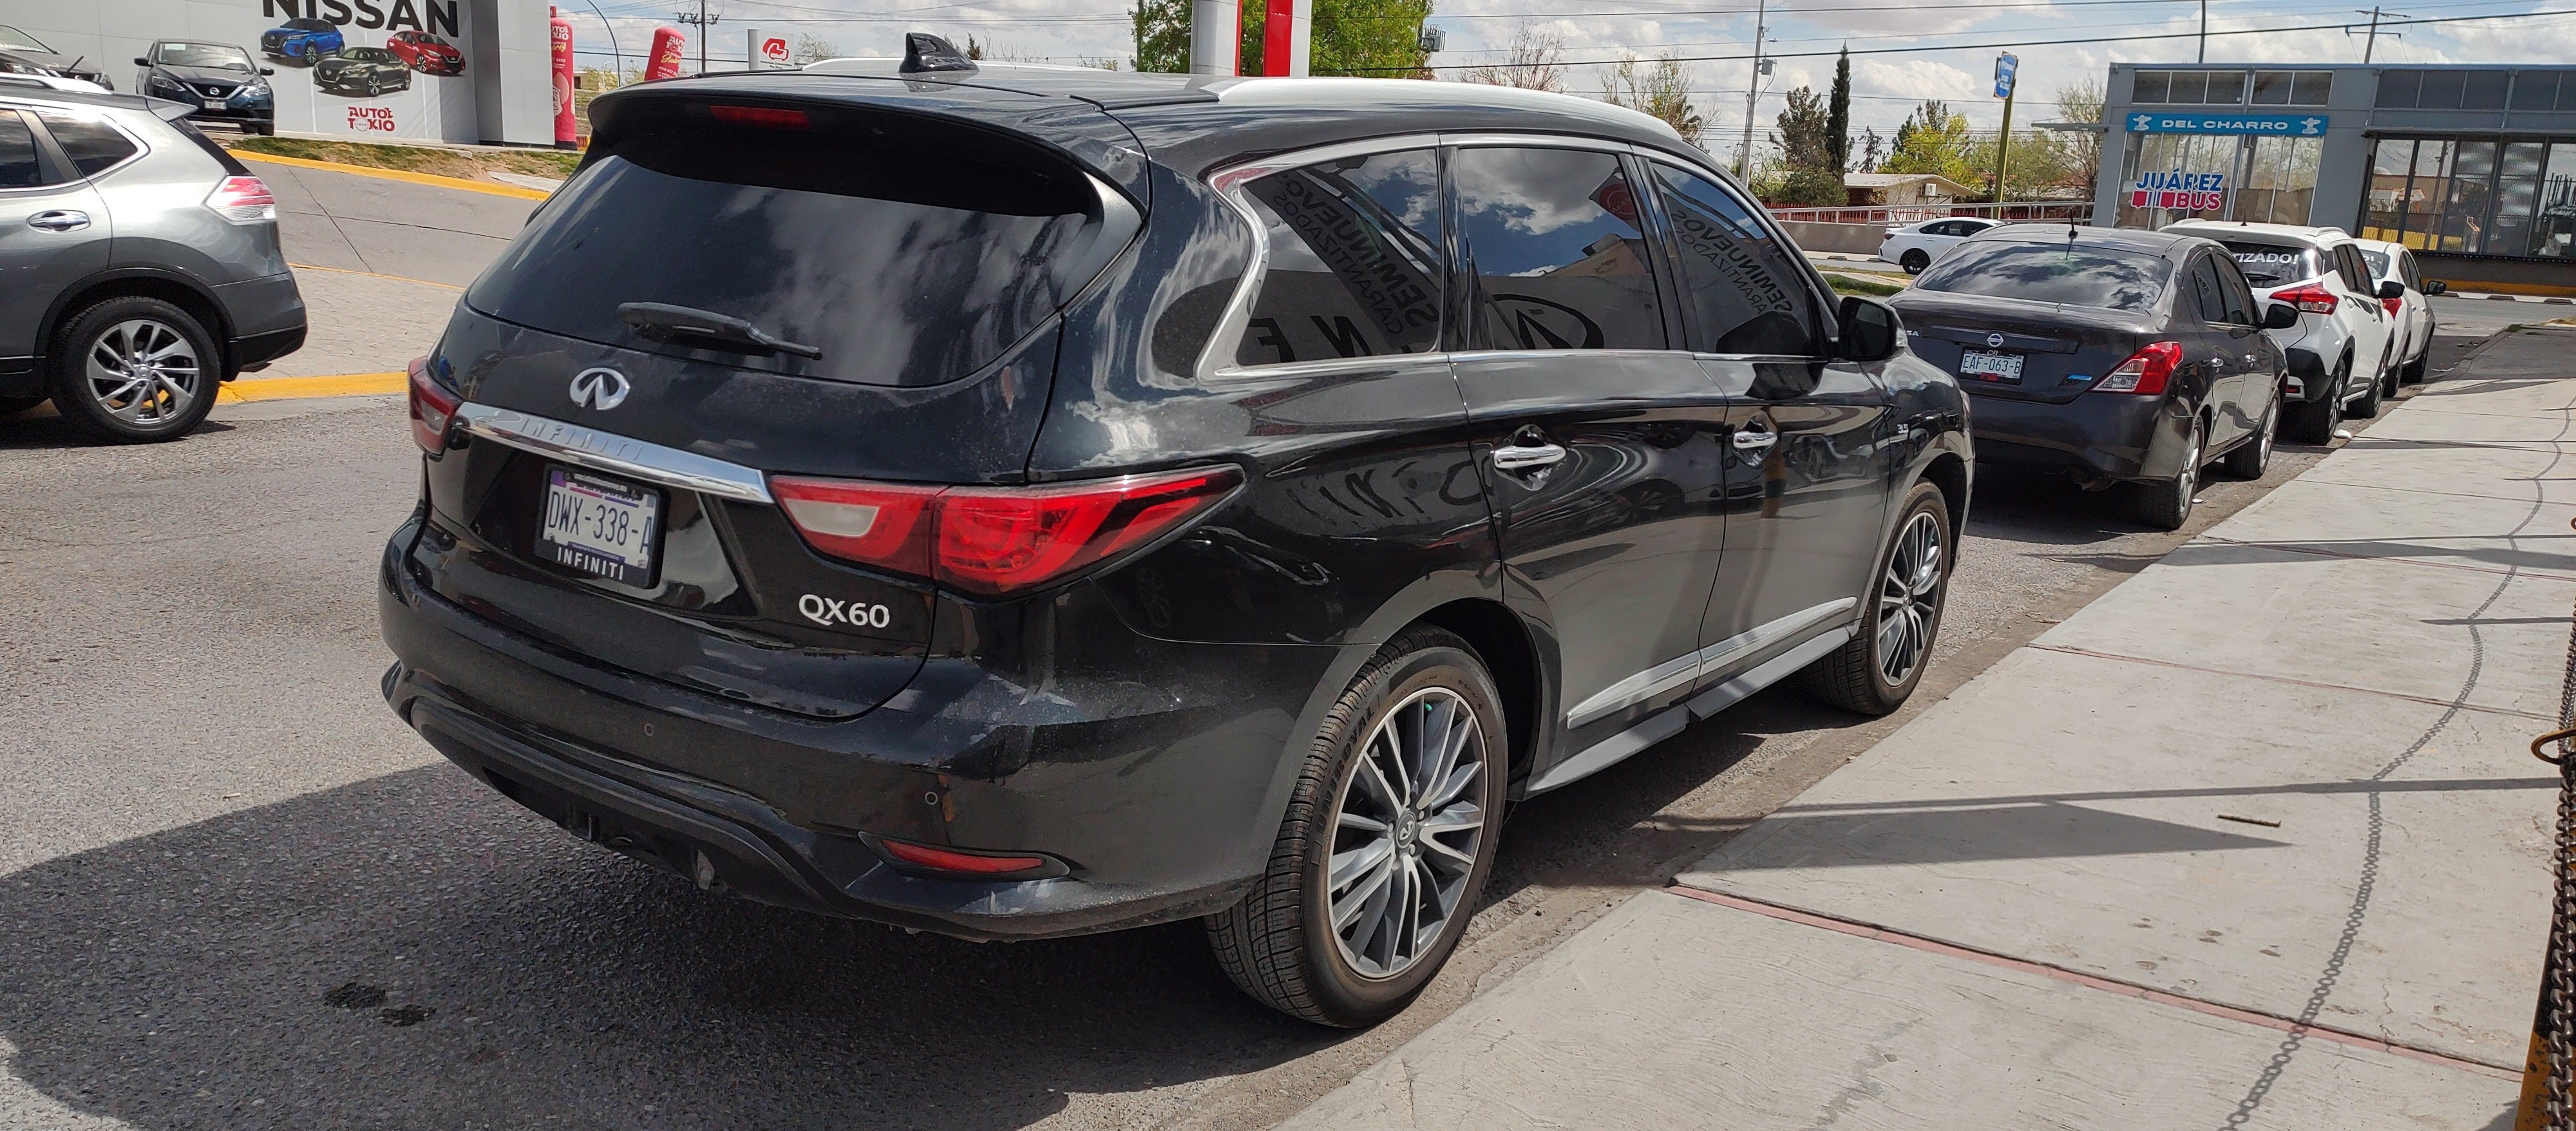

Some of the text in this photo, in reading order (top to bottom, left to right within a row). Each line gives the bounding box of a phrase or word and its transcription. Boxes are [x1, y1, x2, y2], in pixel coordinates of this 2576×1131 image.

[2161, 119, 2289, 131] DEL CHARRO
[2135, 167, 2224, 192] JUÁREZ
[2175, 192, 2222, 211] BUS
[1963, 356, 2022, 375] EAF-063-B
[520, 418, 644, 461] INFINITI
[548, 491, 652, 555] DWX-338-A
[556, 546, 624, 581] INFINITI
[799, 594, 890, 629] QX60
